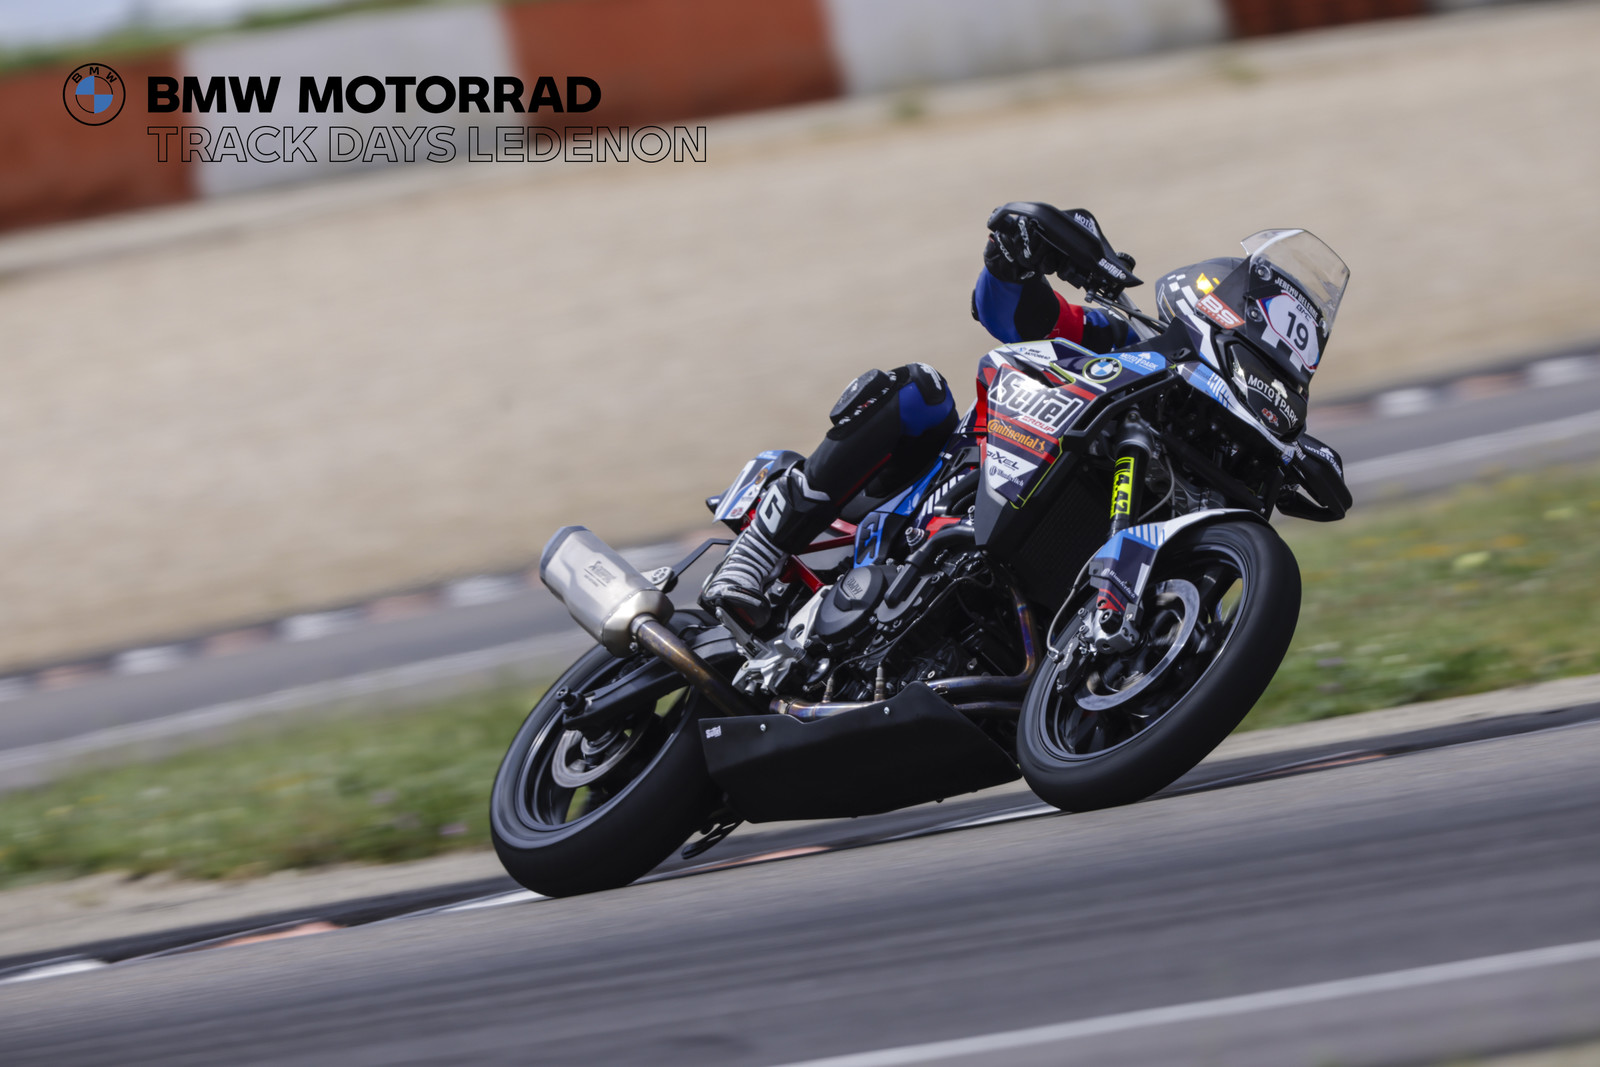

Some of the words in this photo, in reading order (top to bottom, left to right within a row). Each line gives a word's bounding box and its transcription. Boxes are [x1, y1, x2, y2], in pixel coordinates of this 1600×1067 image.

[1275, 277, 1298, 297] JEREMY
[1201, 295, 1240, 325] BS
[1285, 311, 1309, 351] 19
[1119, 353, 1138, 362] MOTO
[1141, 359, 1158, 370] PARK
[1248, 375, 1274, 398] MOTO
[1280, 400, 1298, 426] PARK
[988, 419, 1040, 451] Continental
[1022, 415, 1055, 433] GROUP
